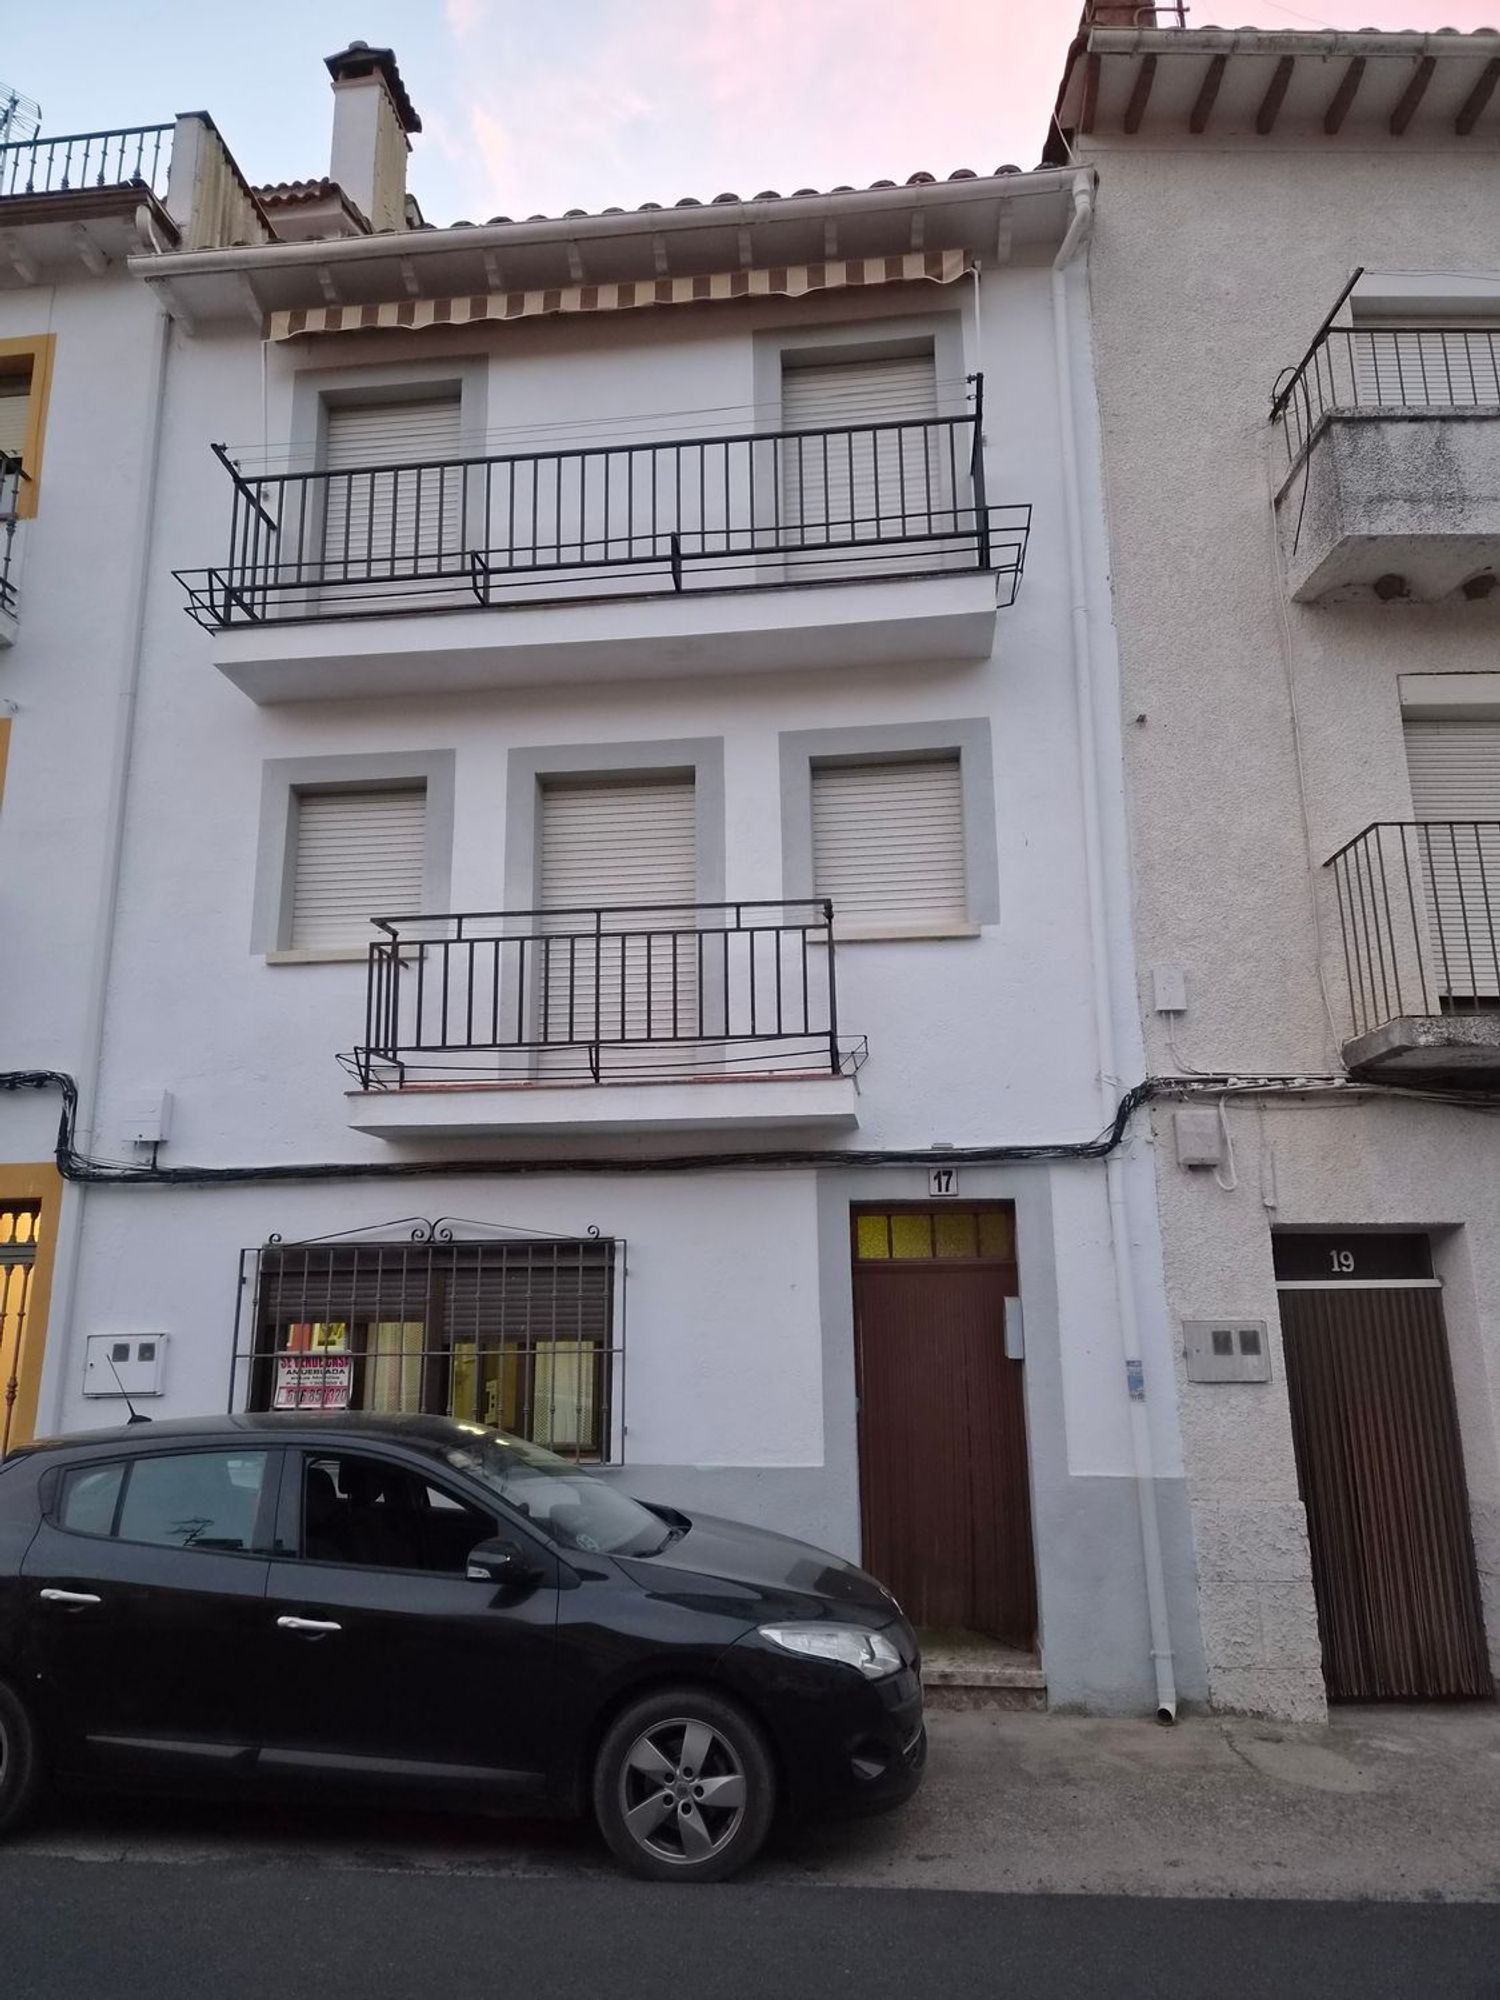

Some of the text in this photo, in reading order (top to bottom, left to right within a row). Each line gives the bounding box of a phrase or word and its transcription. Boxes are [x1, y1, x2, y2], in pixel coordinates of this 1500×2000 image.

[934, 1170, 953, 1192] 17
[1330, 1250, 1355, 1272] 19
[281, 1355, 293, 1369] SE
